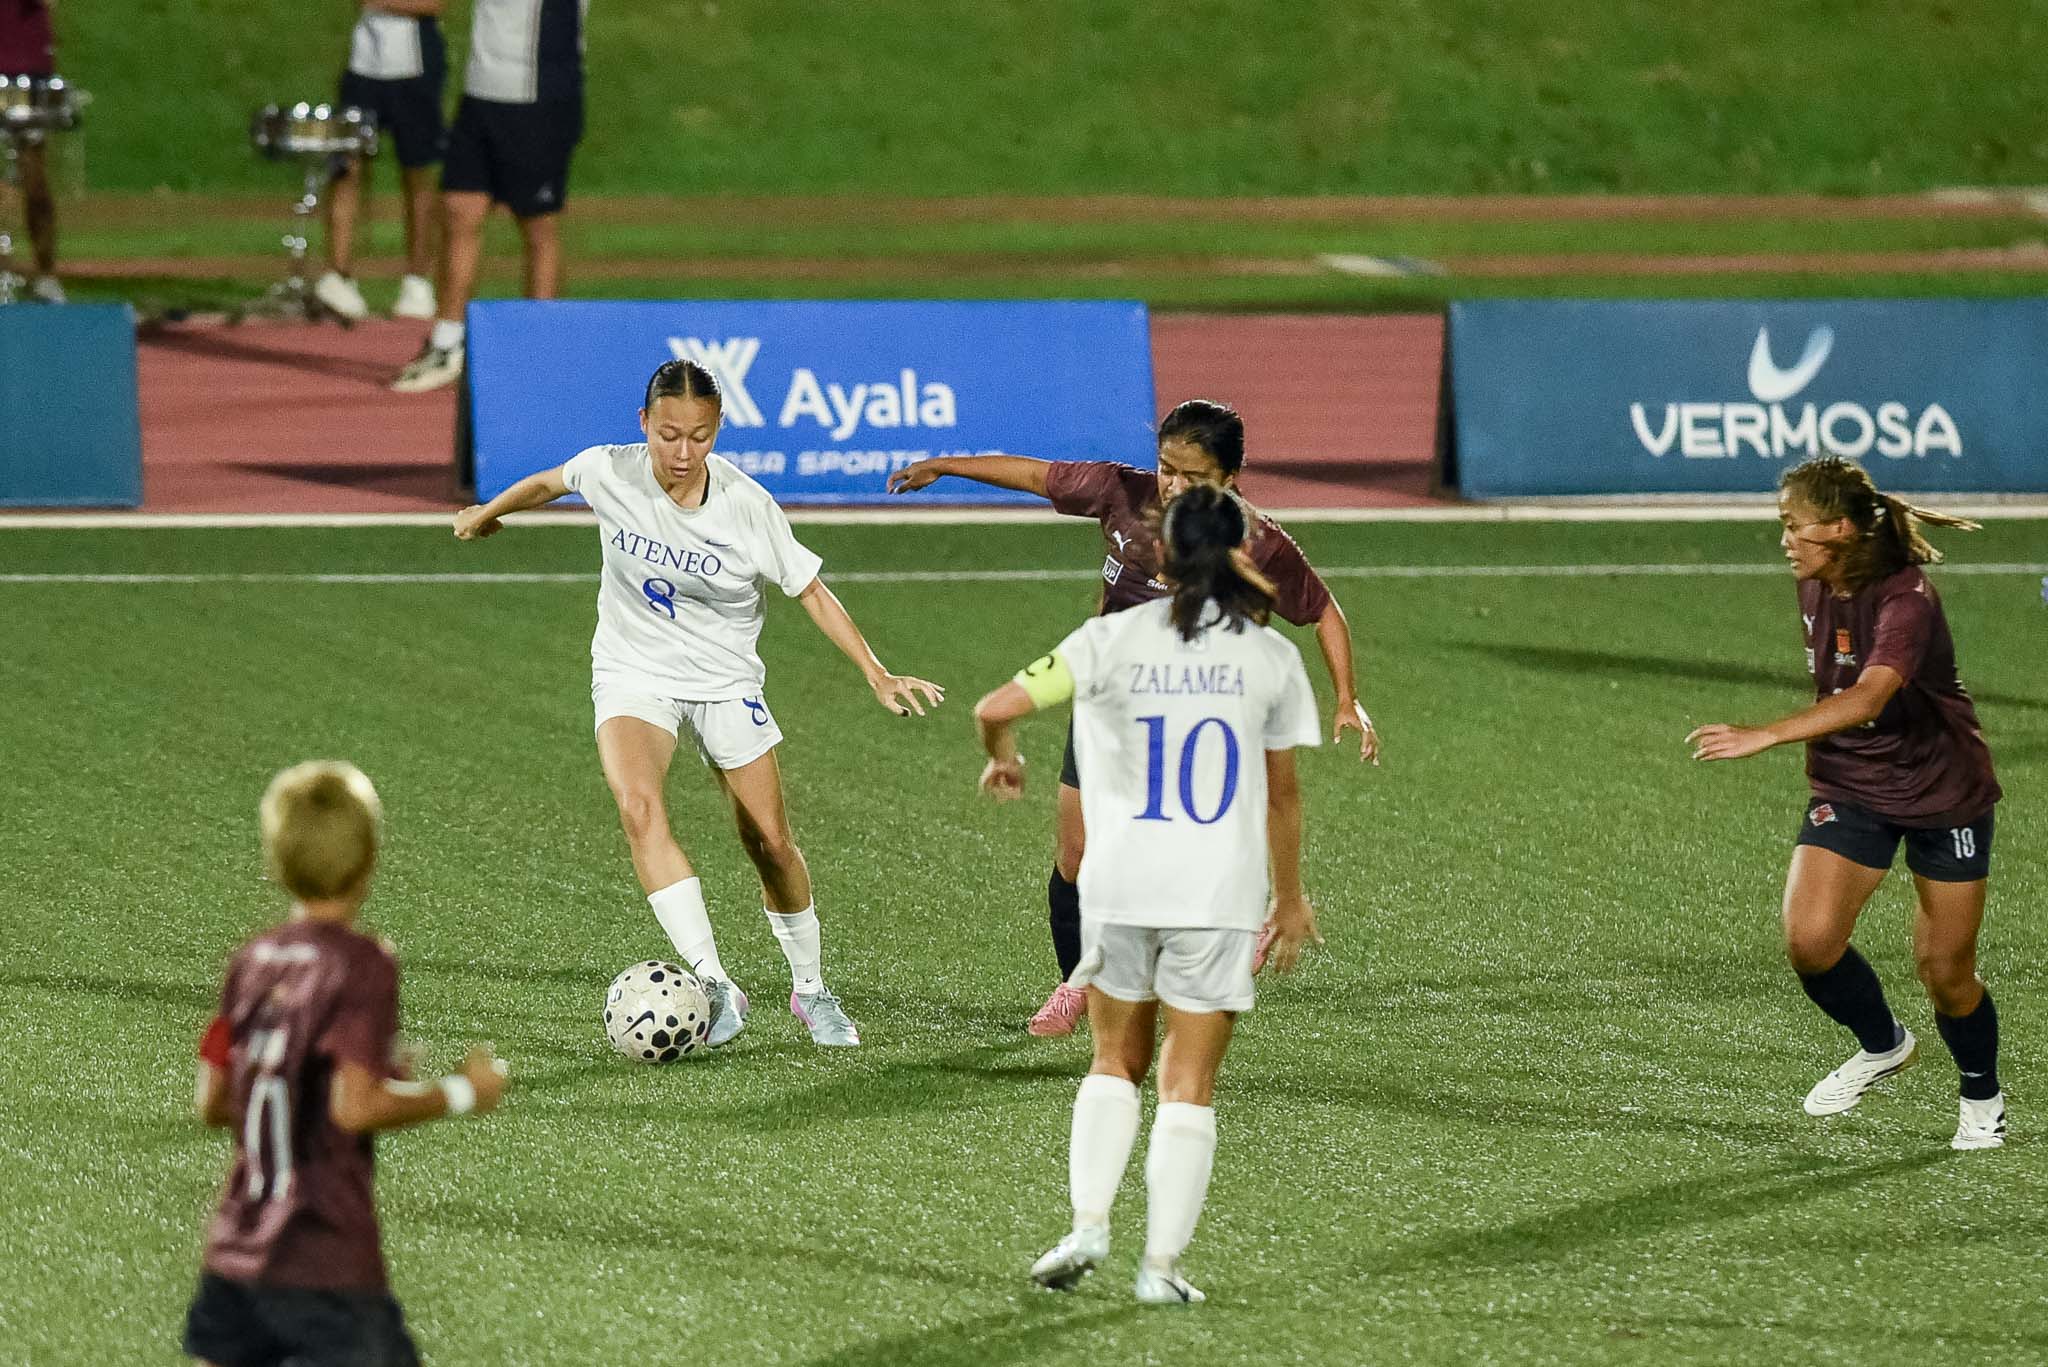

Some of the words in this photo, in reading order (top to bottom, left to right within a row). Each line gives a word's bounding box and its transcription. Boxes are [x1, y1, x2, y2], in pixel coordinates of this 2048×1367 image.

[778, 367, 957, 442] Ayala
[1630, 402, 1963, 459] VERMOSA
[611, 528, 722, 576] ATENEO
[642, 577, 676, 620] 8
[1130, 663, 1245, 696] ZALAMEA
[1133, 715, 1240, 825] 10
